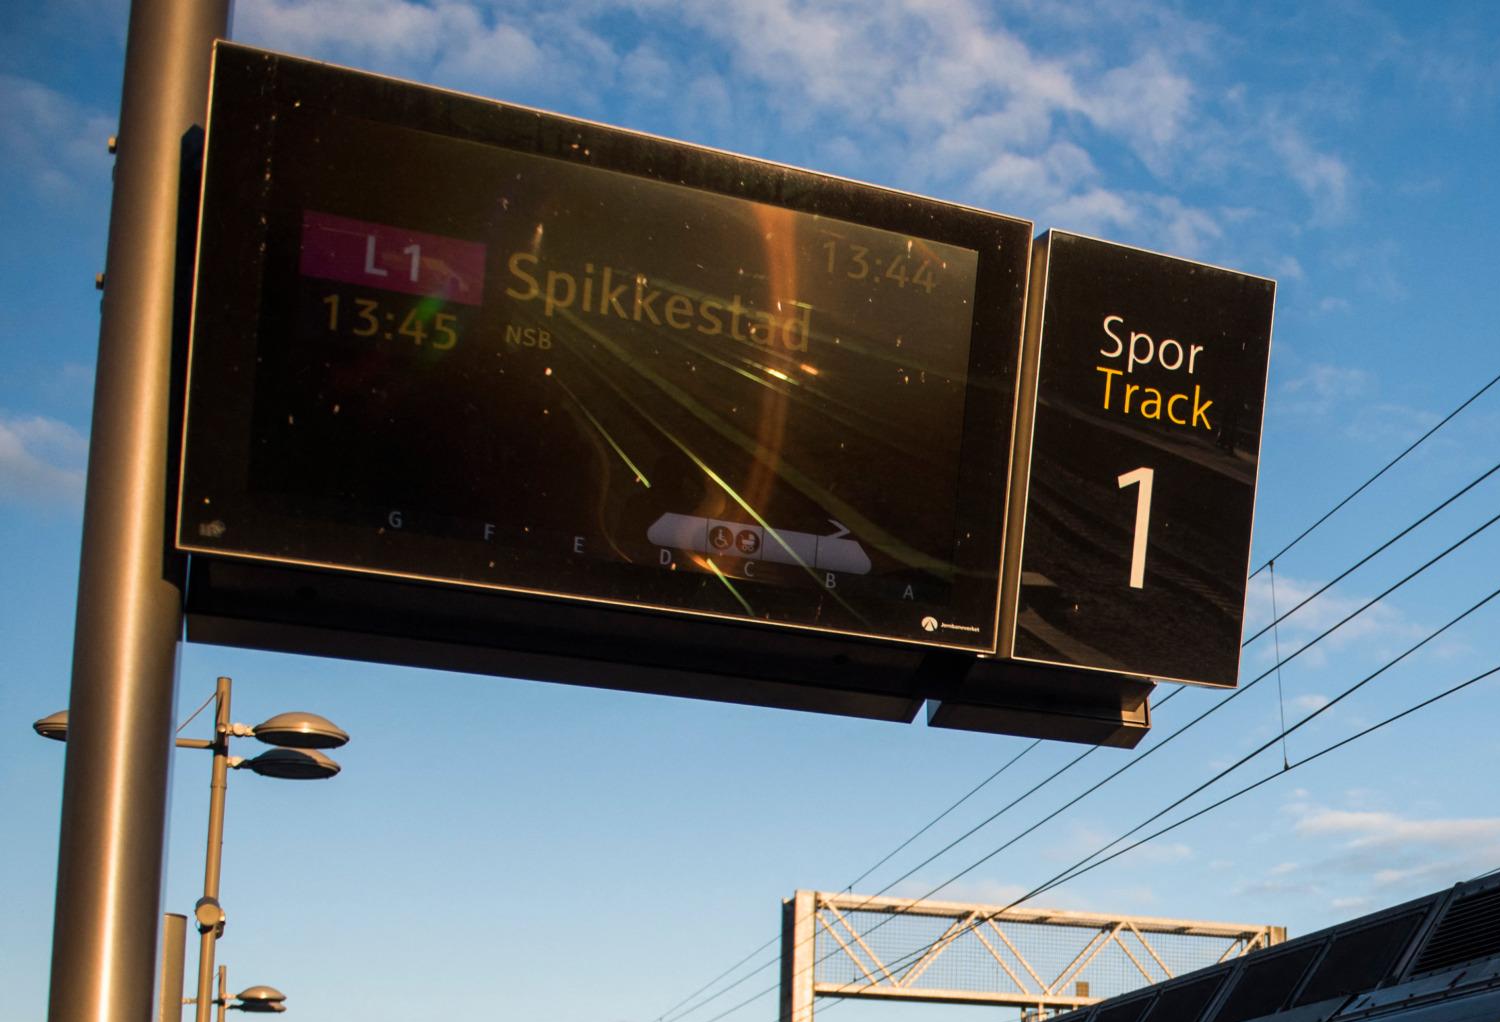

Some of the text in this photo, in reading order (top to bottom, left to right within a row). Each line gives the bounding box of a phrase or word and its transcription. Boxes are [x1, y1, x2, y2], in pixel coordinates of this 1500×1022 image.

[822, 241, 936, 294] 13:44
[322, 294, 458, 350] 13:45
[505, 251, 812, 353] Spikkestad
[505, 323, 552, 350] NSB
[1100, 314, 1204, 375] Spor
[1096, 366, 1214, 430] Track
[388, 511, 914, 600] G F E D C B A
[1117, 465, 1155, 589] 1
